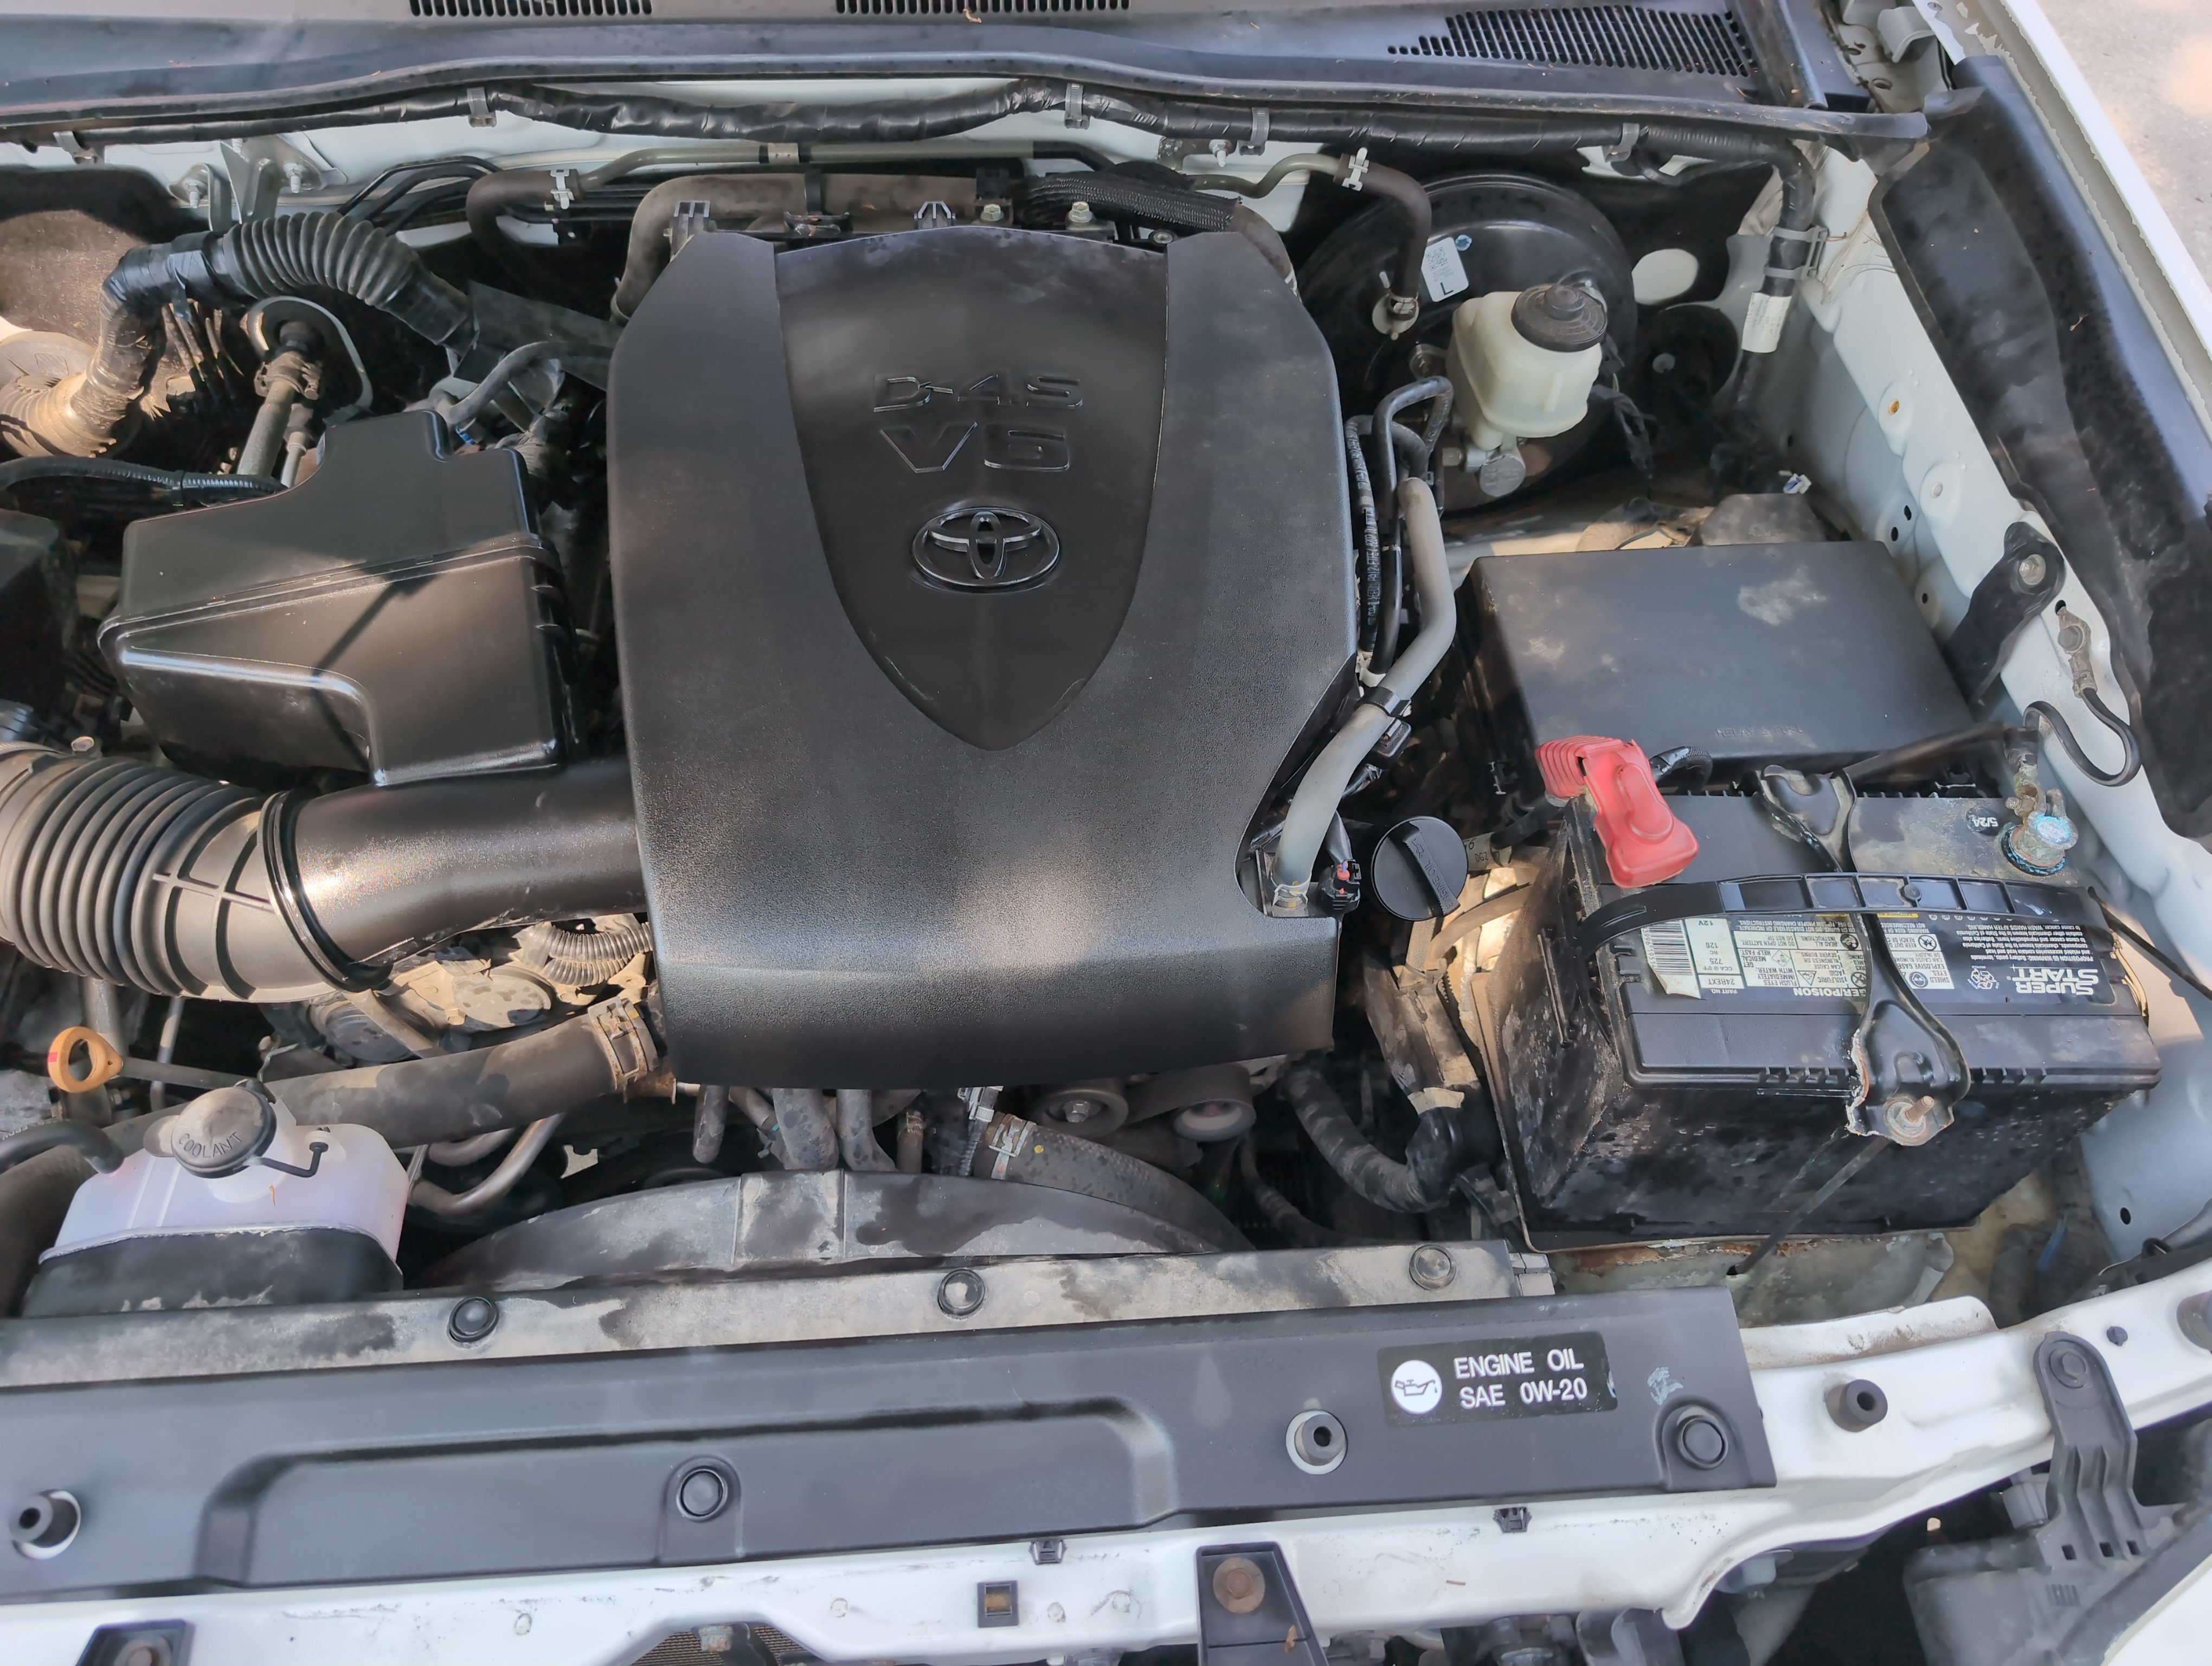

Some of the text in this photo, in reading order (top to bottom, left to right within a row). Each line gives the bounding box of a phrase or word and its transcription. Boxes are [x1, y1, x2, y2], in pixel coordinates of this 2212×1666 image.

[1440, 282, 1454, 296] L
[879, 421, 1071, 475] V6
[1715, 727, 1754, 738] RELAY
[1971, 817, 1998, 827] 5/24
[1424, 860, 1454, 910] ENGINE OIL
[2012, 969, 2099, 984] START
[2015, 982, 2094, 995] SUPER
[178, 1131, 242, 1158] COOLANT
[1454, 1348, 1584, 1380] ENGINE OIL
[1459, 1377, 1588, 1409] SAE 0W-20
